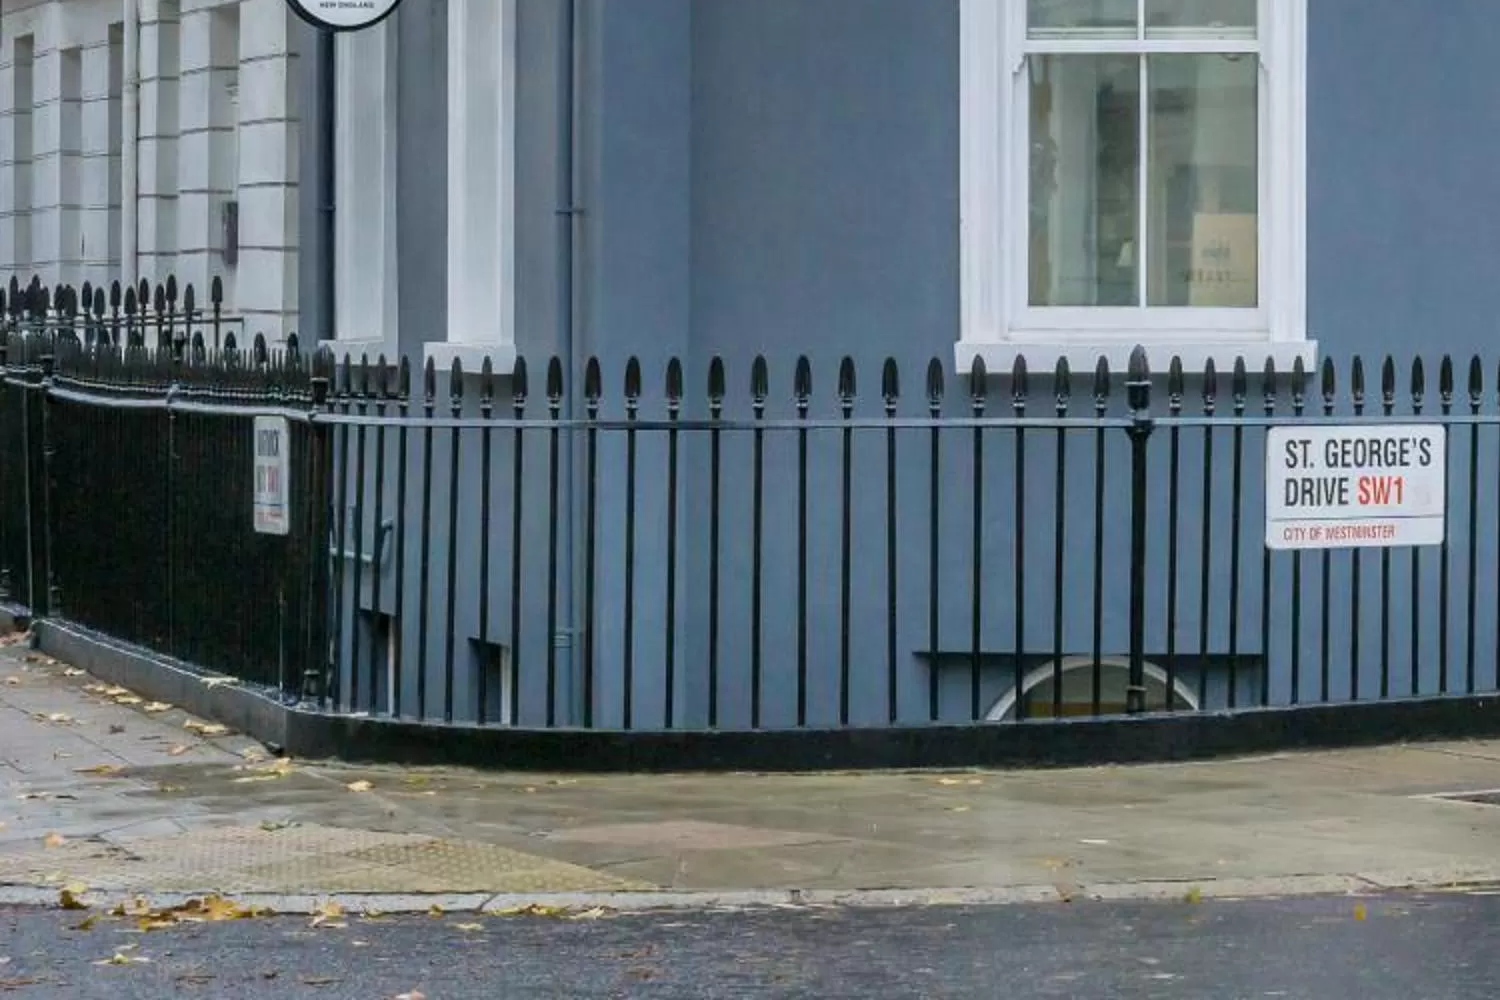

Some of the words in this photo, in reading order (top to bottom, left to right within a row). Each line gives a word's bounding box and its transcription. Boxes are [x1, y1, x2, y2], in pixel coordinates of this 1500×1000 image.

[1285, 439, 1314, 468] ST.
[1325, 438, 1432, 468] GEORGE'S
[1284, 477, 1349, 506] DRIVE
[1358, 475, 1404, 505] SW1
[1283, 527, 1306, 541] CITY
[1309, 526, 1323, 541] OF
[1325, 525, 1395, 540] WESTMINSTER
